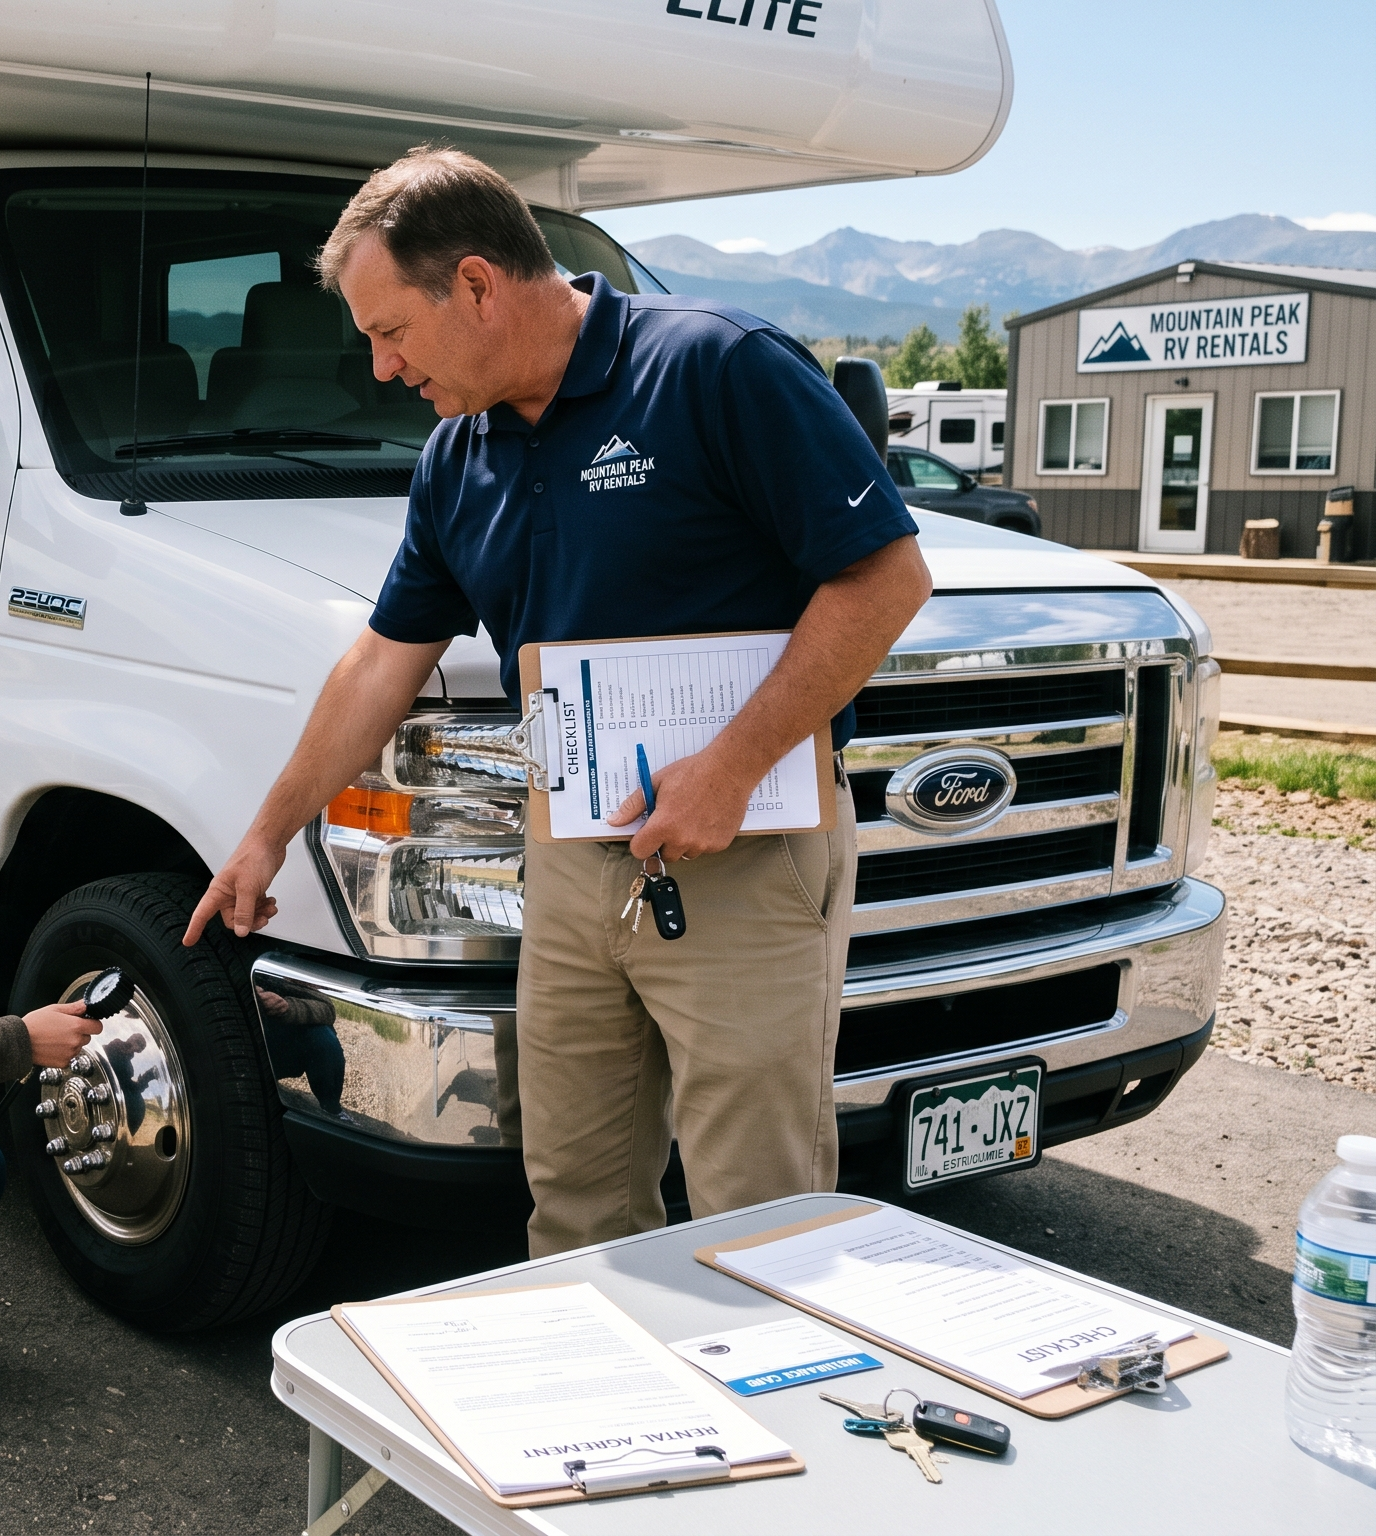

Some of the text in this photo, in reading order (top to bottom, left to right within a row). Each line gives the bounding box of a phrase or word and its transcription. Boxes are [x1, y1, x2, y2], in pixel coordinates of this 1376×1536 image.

[1150, 302, 1301, 333] MOUNTAIN PEAK
[1164, 330, 1289, 360] RV RENTALS
[580, 456, 655, 482] MOUNTAIN PEAK
[589, 473, 646, 492] RV RENTALS
[563, 702, 579, 775] CHECKLIST
[934, 772, 991, 807] Ford
[640, 1426, 719, 1443] RENTAL
